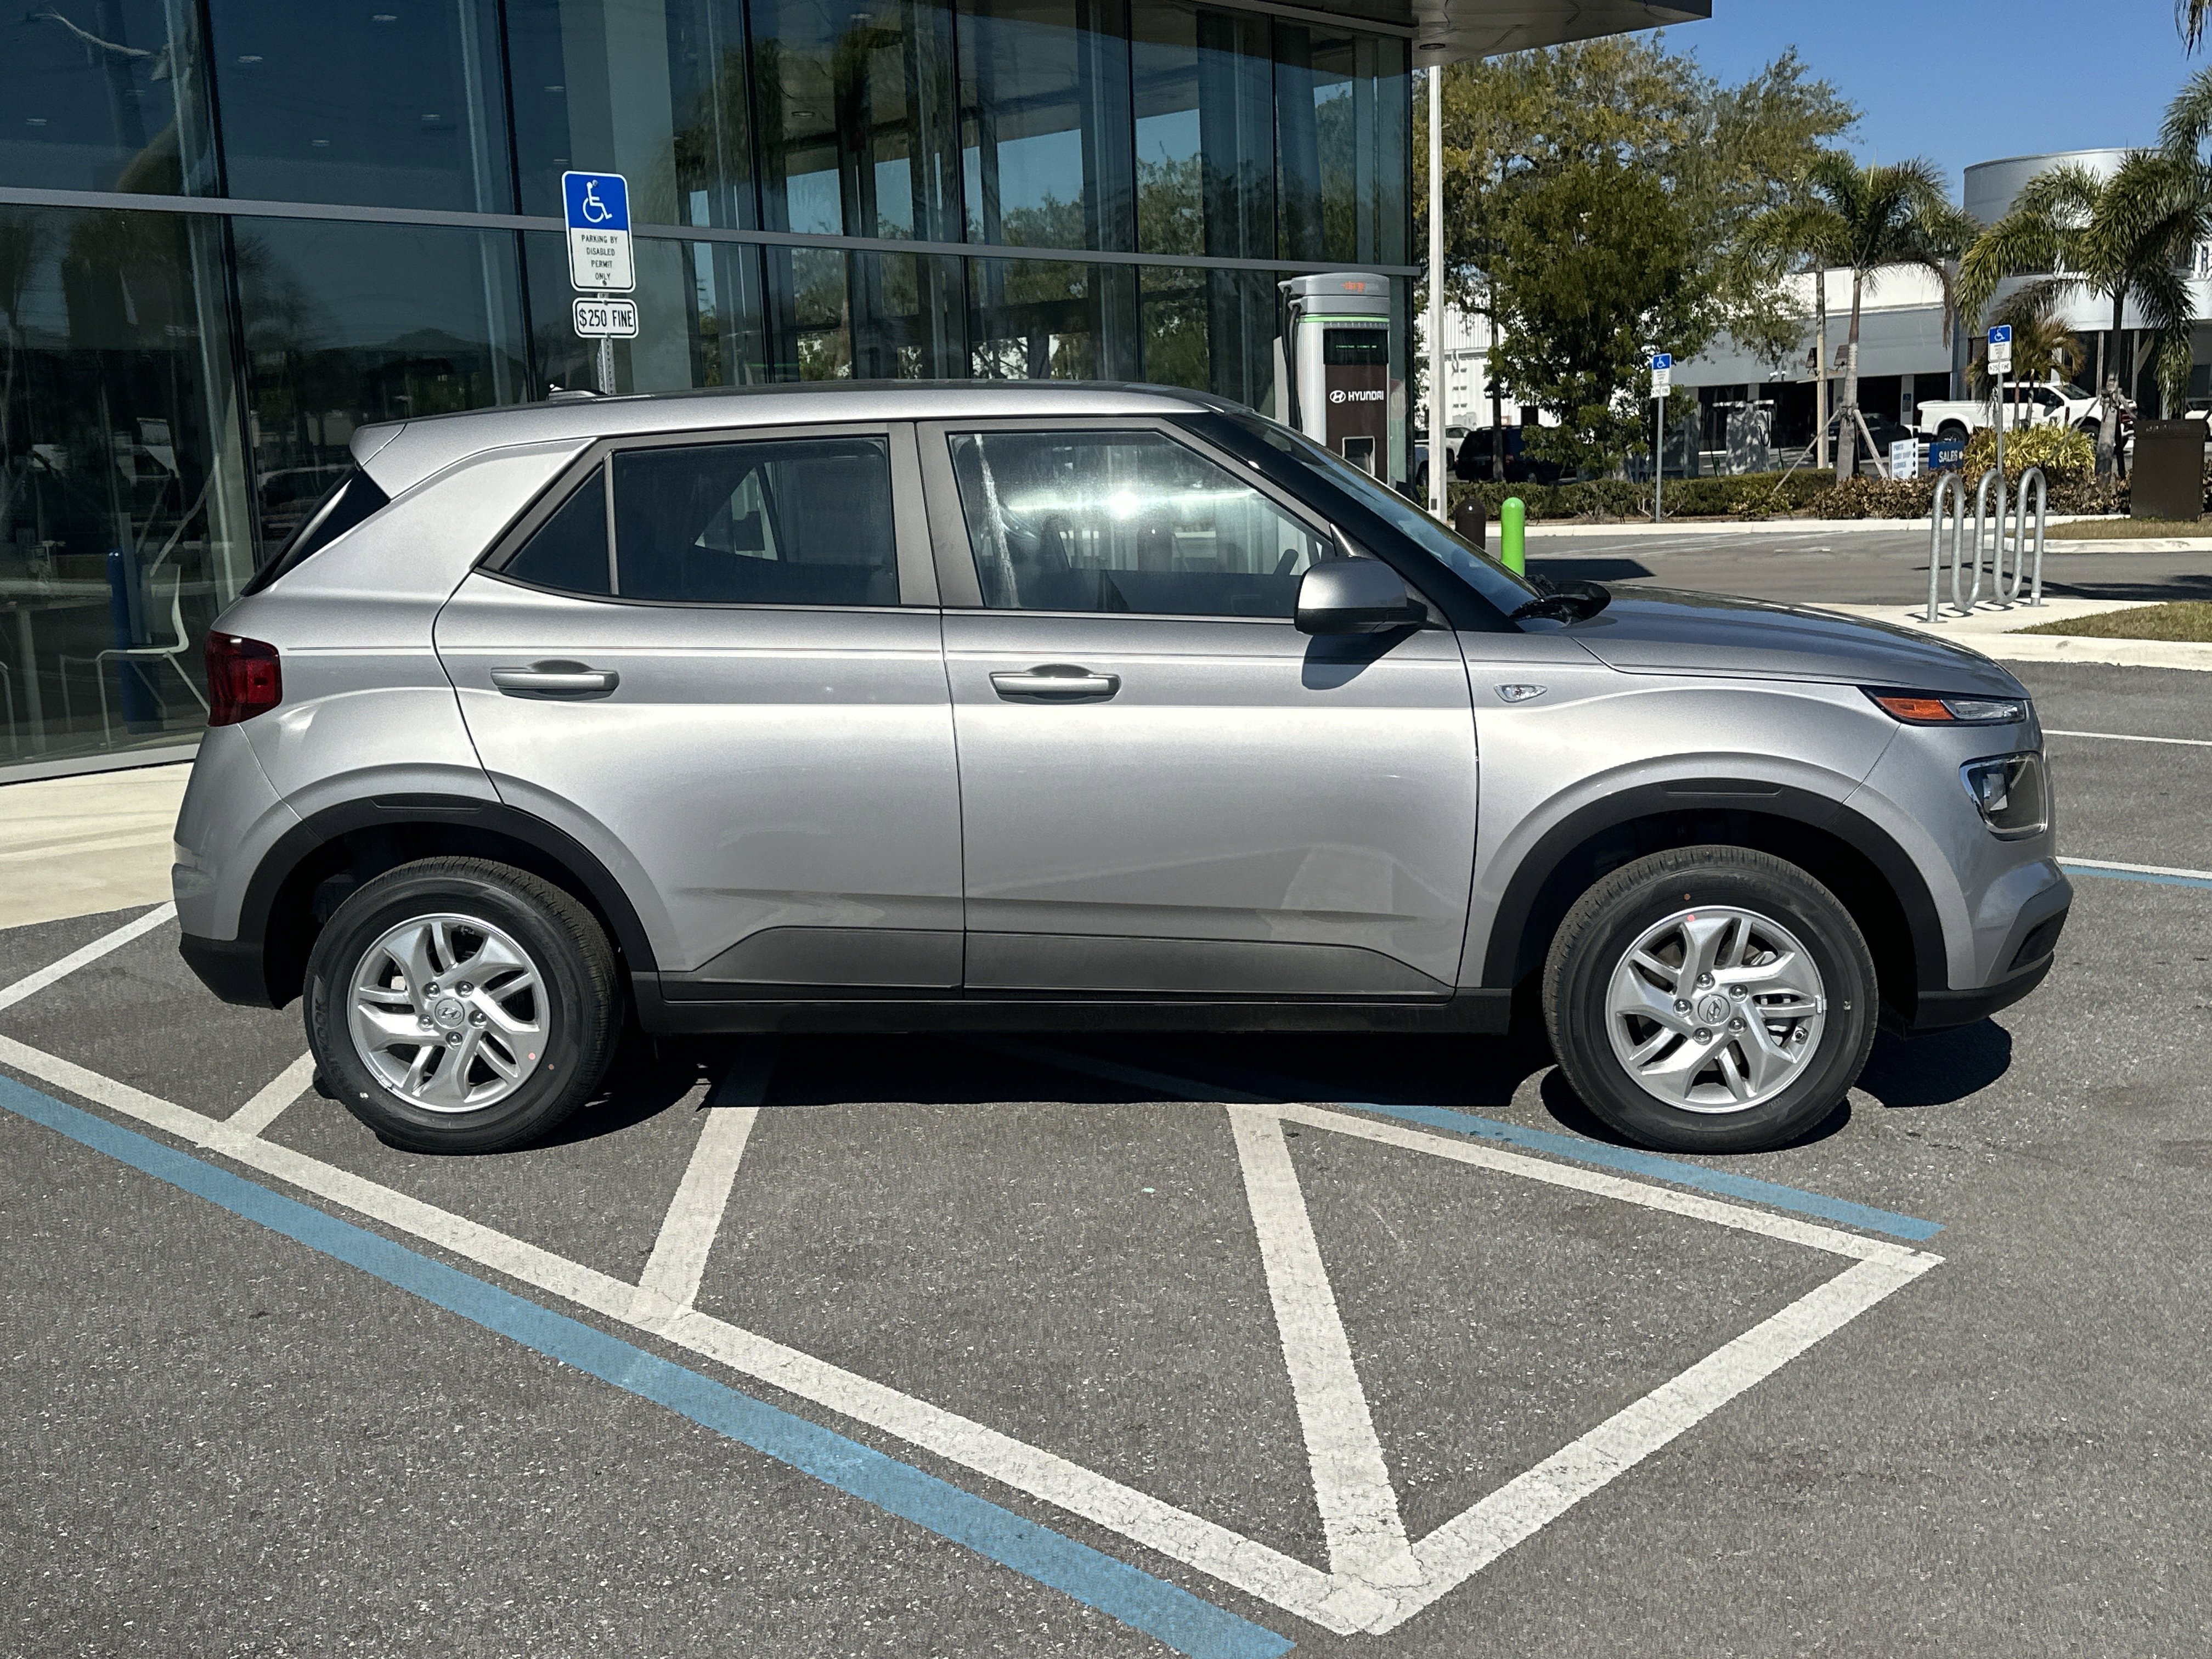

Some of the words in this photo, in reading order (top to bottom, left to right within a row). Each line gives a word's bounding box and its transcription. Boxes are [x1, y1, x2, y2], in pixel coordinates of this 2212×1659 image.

[581, 234, 607, 244] PARKING
[610, 235, 618, 244] BY
[586, 246, 616, 256] DISABLED
[591, 259, 613, 268] PERMIT
[595, 272, 611, 281] ONLY
[579, 308, 607, 329] $250
[612, 310, 634, 328] FINE
[1348, 390, 1384, 402] HYUNDAI
[1938, 450, 1957, 463] SALES
